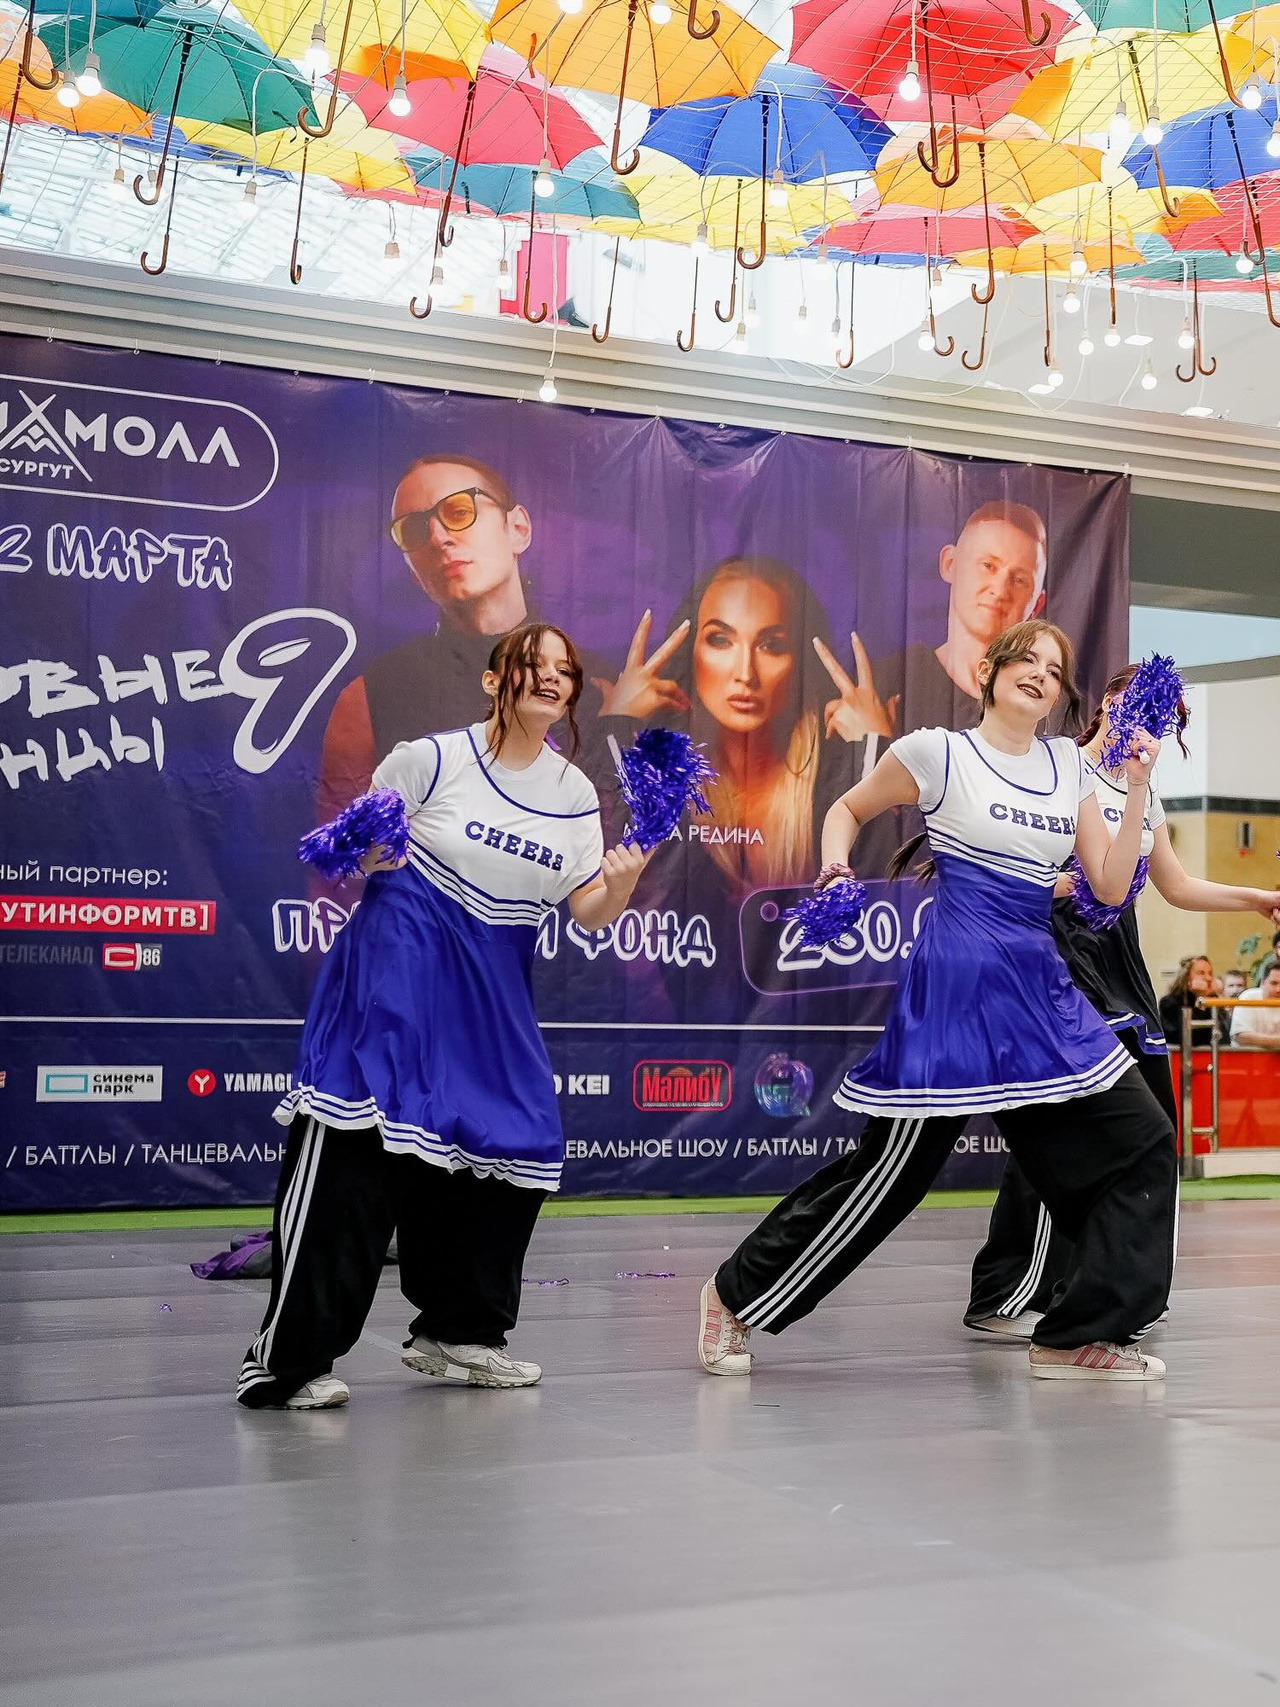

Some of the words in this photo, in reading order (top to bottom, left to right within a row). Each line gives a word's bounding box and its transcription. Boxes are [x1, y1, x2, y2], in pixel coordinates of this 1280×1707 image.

[47, 522, 233, 592] МАРТА
[465, 821, 563, 871] CHEERS
[688, 824, 765, 846] РЕДИНА
[49, 866, 168, 889] партнер:
[93, 1072, 154, 1084] синема
[568, 1074, 611, 1095] KEI
[93, 1084, 135, 1096] парк
[25, 1145, 116, 1166] БАТТЛЫ
[563, 1138, 672, 1160] ЕВАЛЬНОЕ
[678, 1138, 729, 1158] ШОУ
[747, 1138, 817, 1157] БАТТЛЫ
